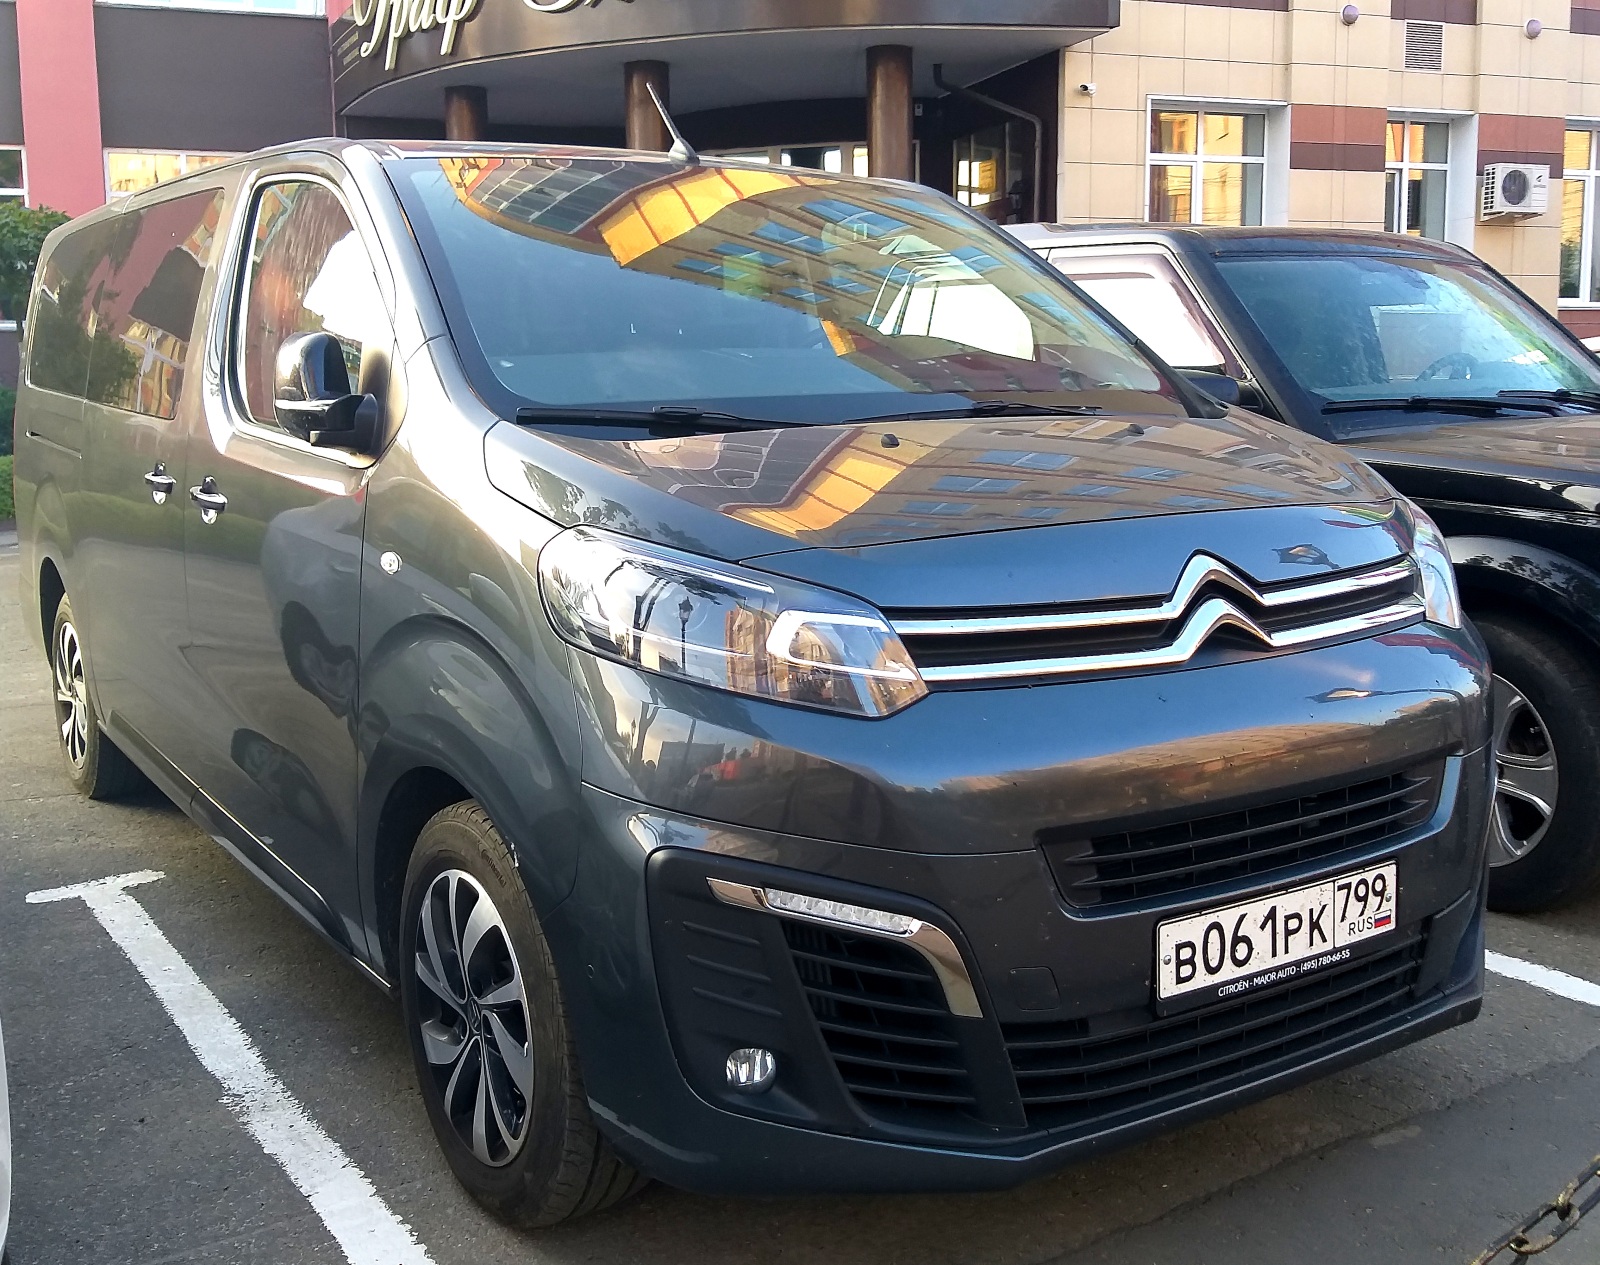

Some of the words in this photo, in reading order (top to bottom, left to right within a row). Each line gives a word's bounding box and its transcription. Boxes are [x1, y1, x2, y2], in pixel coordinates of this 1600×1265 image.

[1337, 872, 1388, 923] 799
[1348, 916, 1374, 936] RUS
[1253, 971, 1277, 987] MAJOR
[1277, 965, 1296, 979] AUTO
[1300, 959, 1318, 973] (495)
[1318, 949, 1351, 967] 780-66-55
